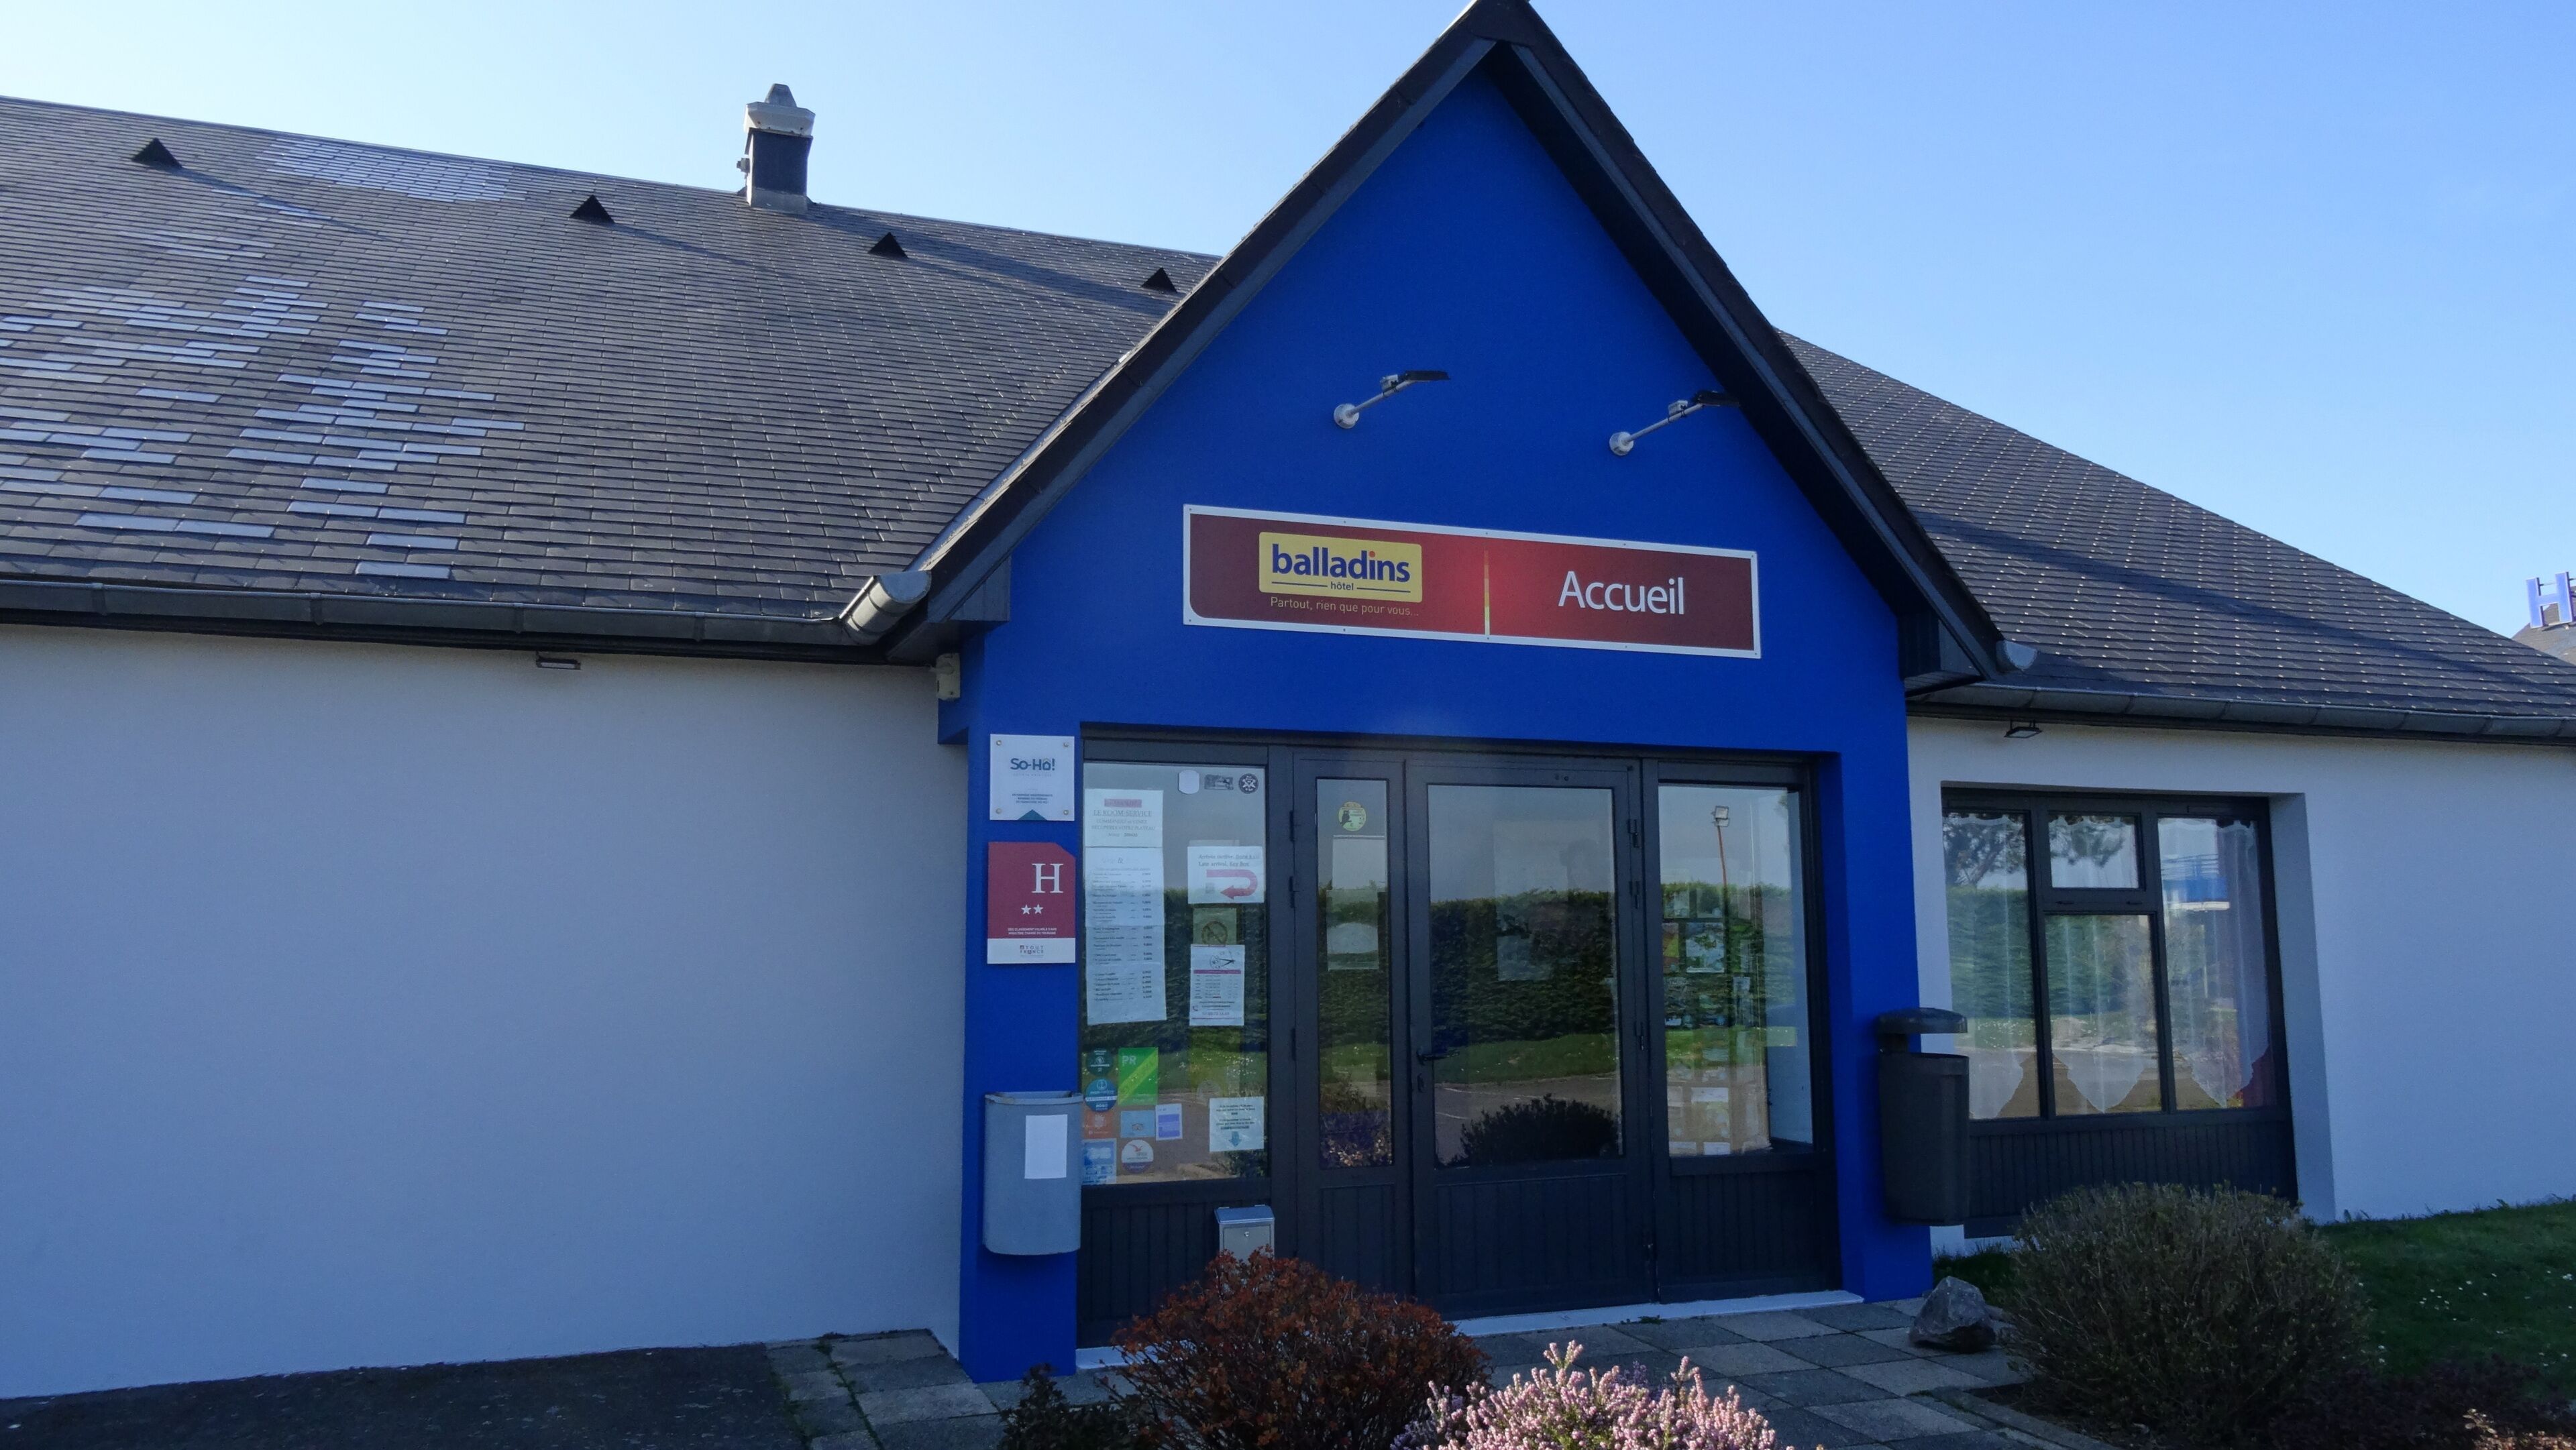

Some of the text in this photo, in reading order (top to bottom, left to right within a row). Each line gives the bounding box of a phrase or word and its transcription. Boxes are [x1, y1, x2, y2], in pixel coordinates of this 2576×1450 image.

[1272, 543, 1410, 582] balladins
[1330, 581, 1354, 591] hôtel
[1558, 571, 1684, 614] Accueil
[1271, 596, 1313, 610] Partout,
[1316, 600, 1336, 610] rien
[1340, 602, 1358, 614] que
[1361, 604, 1384, 615] pour
[1032, 863, 1064, 893] H
